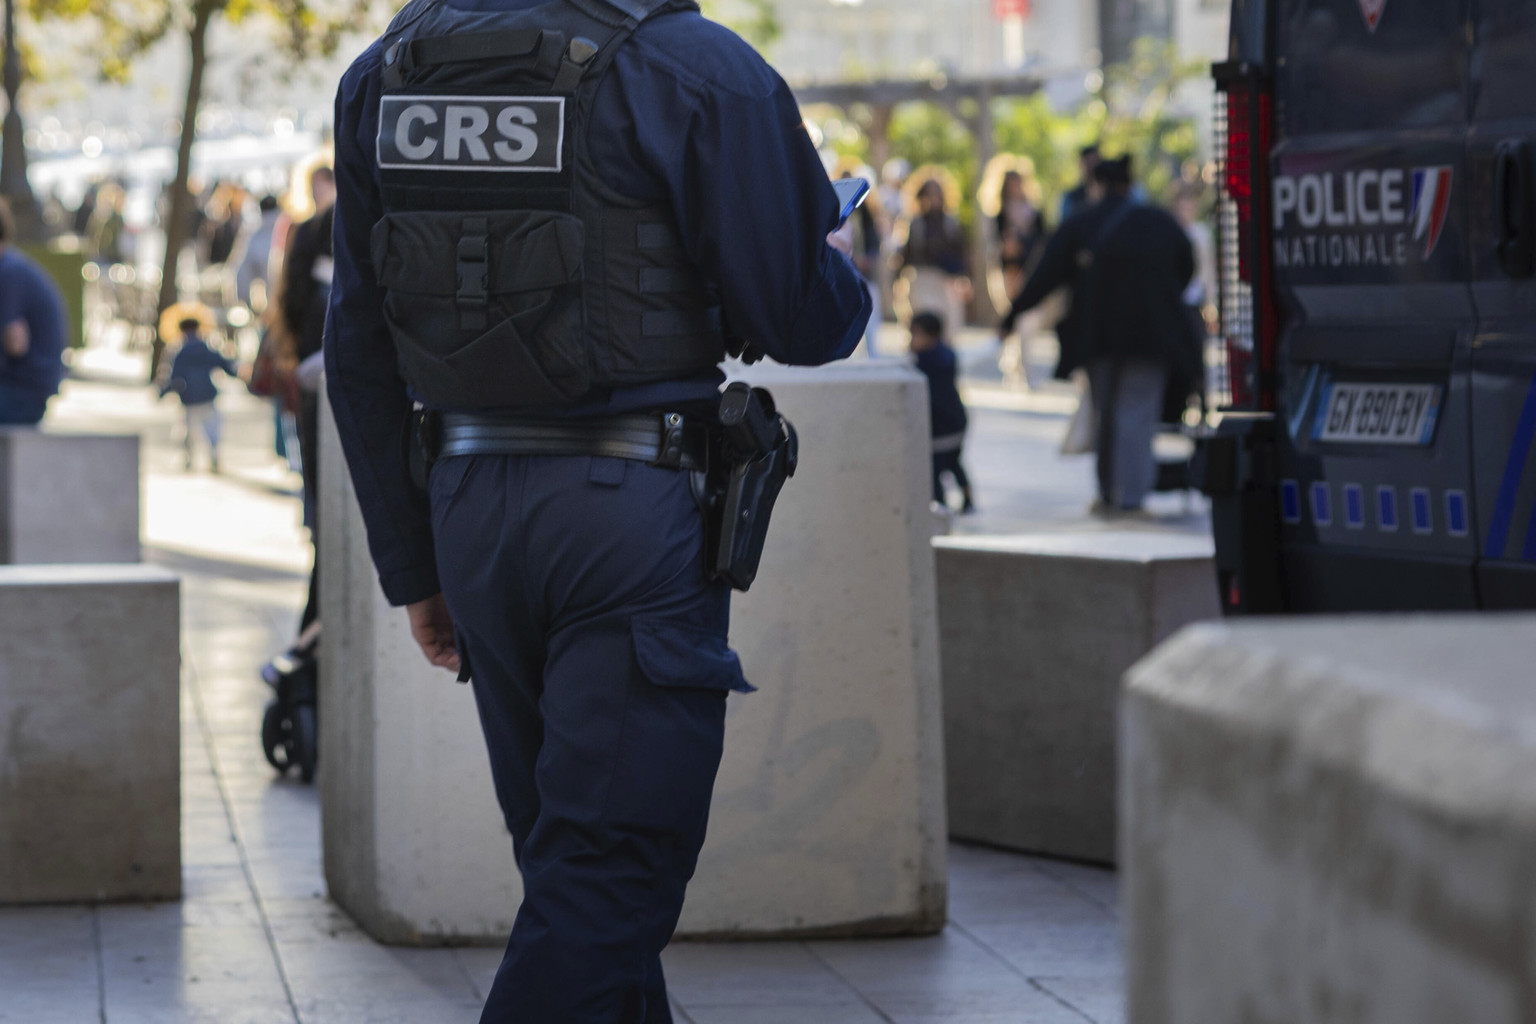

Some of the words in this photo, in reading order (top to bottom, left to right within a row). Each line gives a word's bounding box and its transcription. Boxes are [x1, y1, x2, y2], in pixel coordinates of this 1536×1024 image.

[394, 104, 539, 162] CRS
[1273, 168, 1405, 229] POLICE
[1273, 233, 1406, 266] NATIONALE
